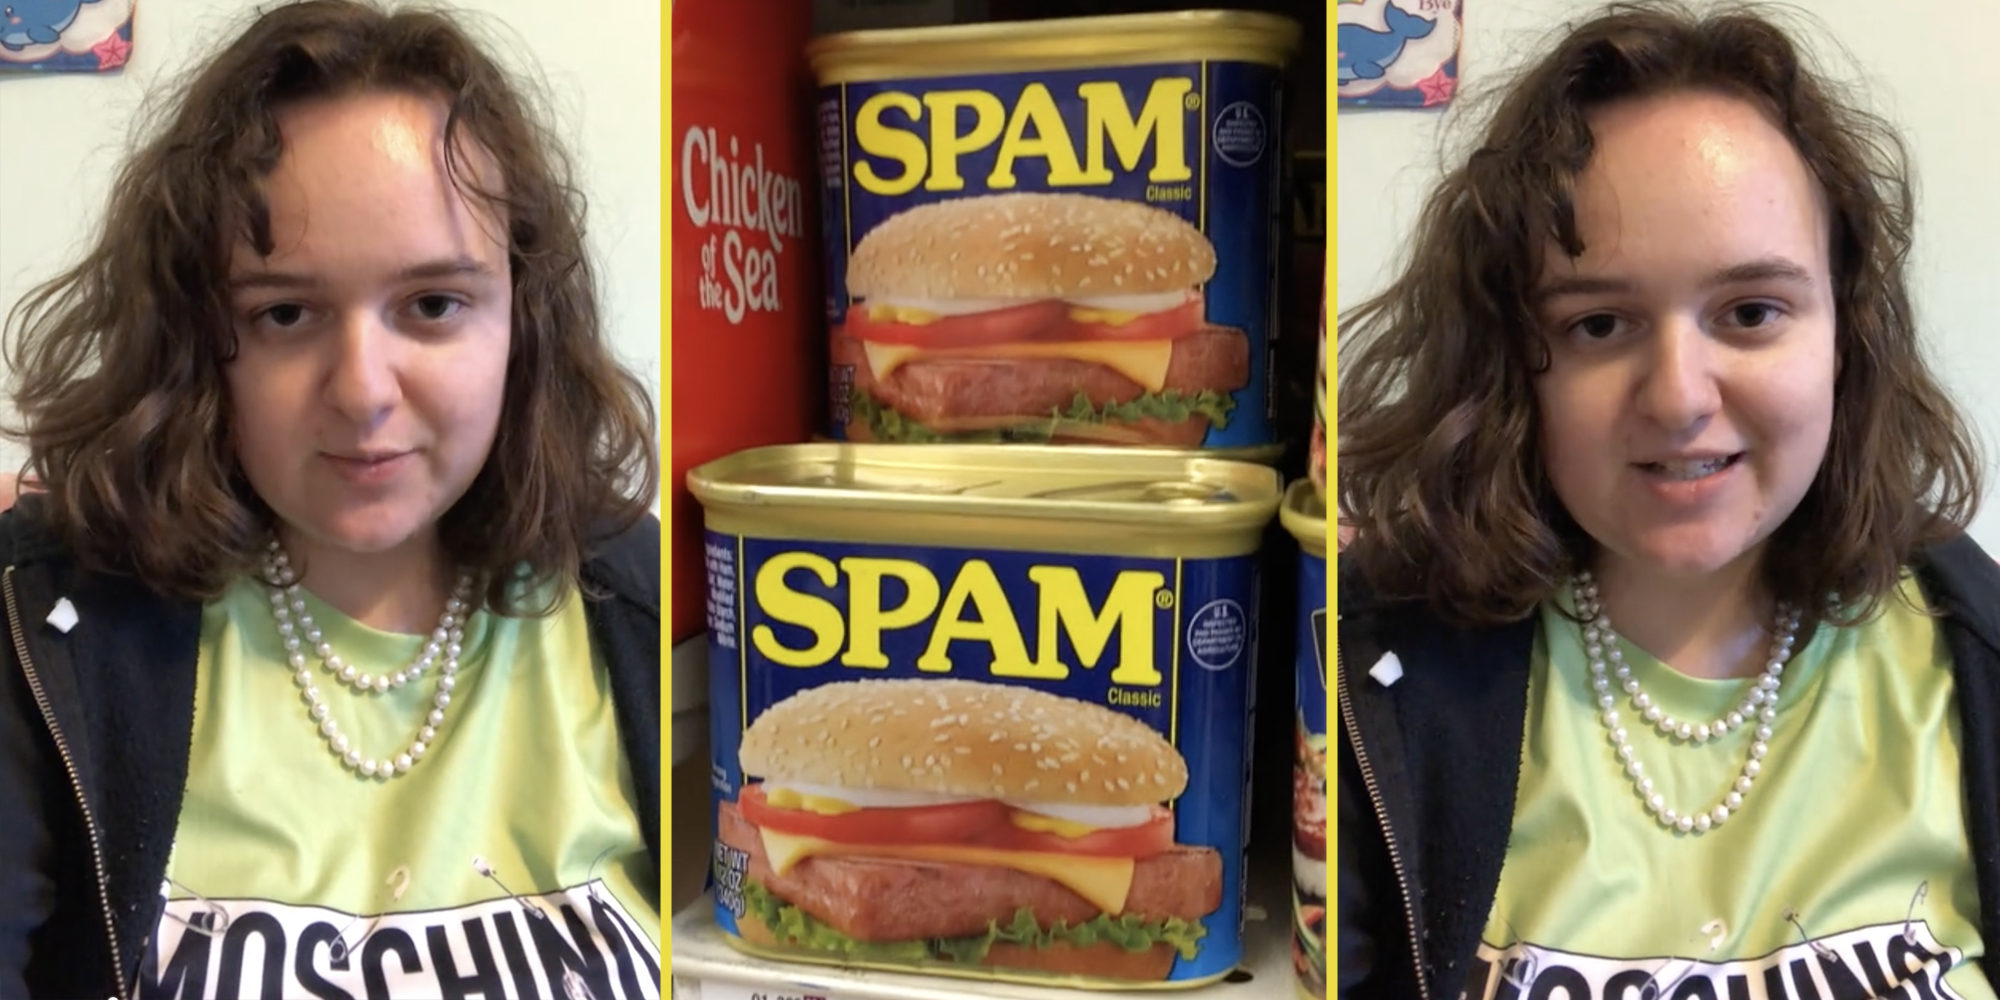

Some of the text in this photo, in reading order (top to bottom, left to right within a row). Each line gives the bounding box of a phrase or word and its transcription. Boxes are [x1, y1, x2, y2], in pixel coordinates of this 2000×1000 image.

[682, 126, 803, 253] Chicken
[1146, 184, 1192, 202] Classic
[699, 274, 723, 310] the
[702, 230, 780, 324] of Sea
[1107, 687, 1163, 708] Classic
